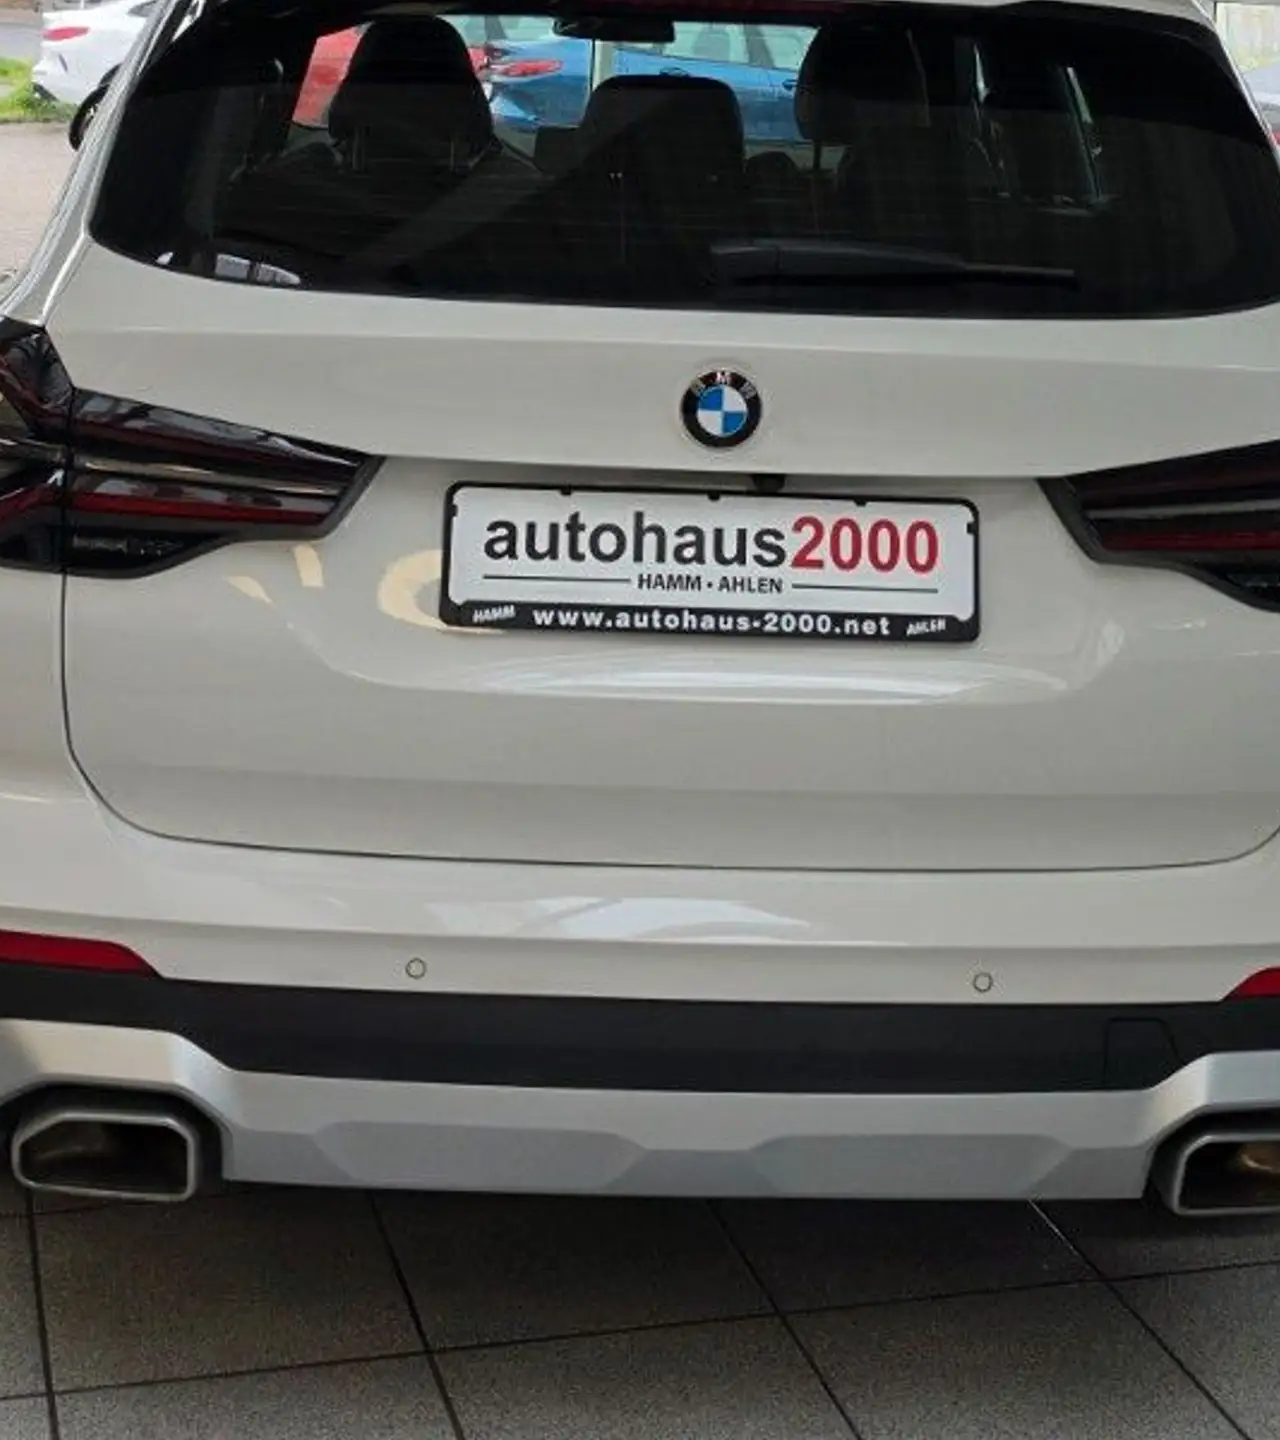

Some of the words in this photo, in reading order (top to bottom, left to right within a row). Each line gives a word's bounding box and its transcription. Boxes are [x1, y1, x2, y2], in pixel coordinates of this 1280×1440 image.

[483, 511, 939, 574] autohaus2000
[638, 573, 702, 591] HAMM
[718, 576, 783, 594] AHLEN
[532, 609, 892, 637] www.autohaus-2000.net
